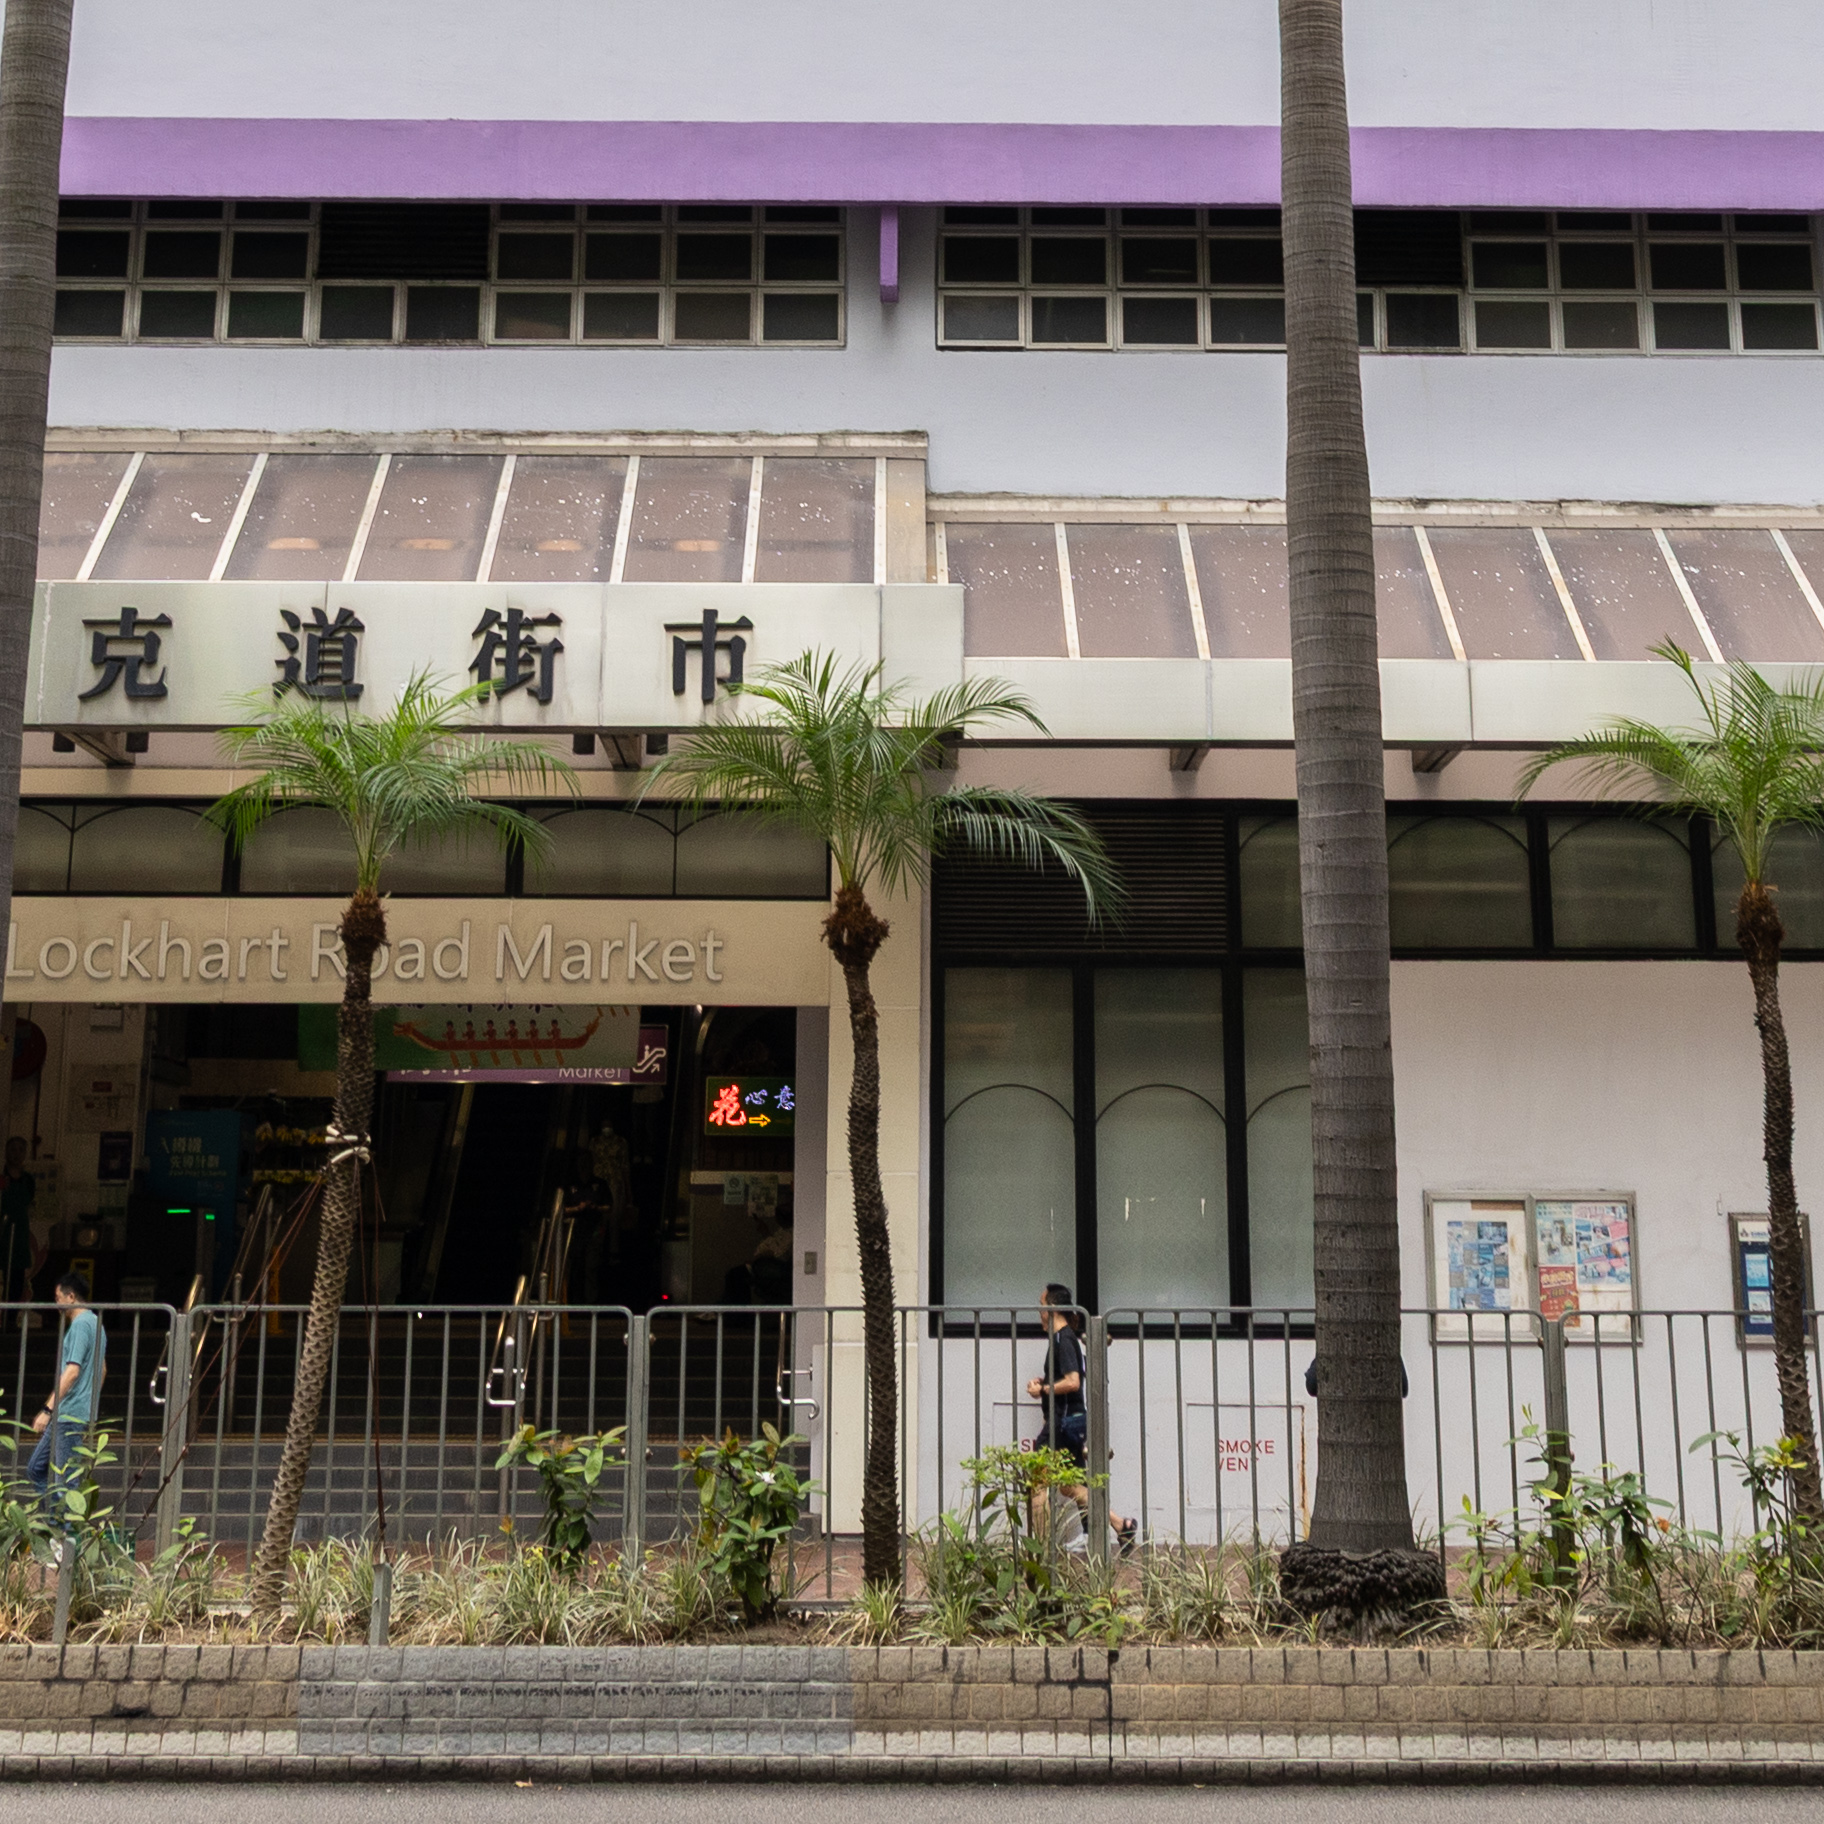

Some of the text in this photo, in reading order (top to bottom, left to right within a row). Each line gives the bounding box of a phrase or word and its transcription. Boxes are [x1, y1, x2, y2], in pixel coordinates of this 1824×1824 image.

[6, 920, 288, 980] Lockhart
[495, 922, 724, 982] Market
[708, 1084, 747, 1126] 花
[1218, 1439, 1275, 1454] SMOKE
